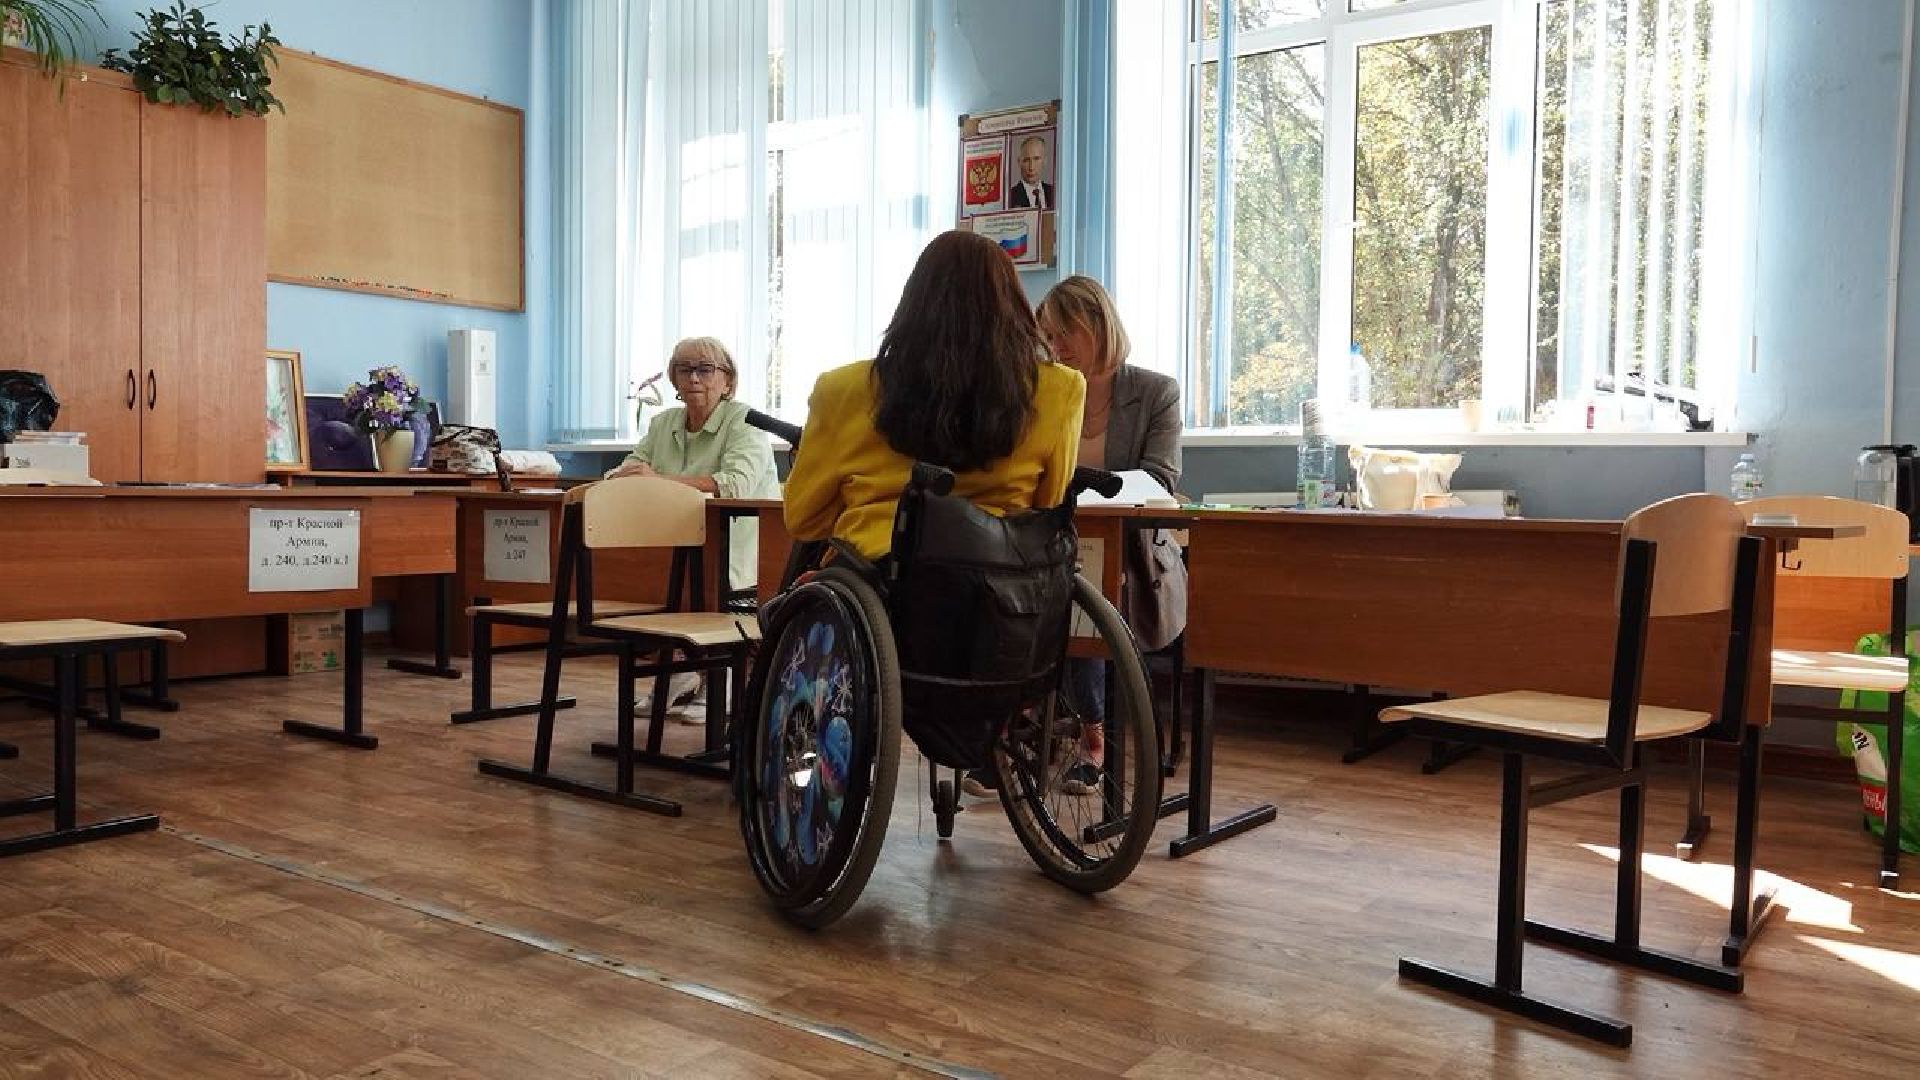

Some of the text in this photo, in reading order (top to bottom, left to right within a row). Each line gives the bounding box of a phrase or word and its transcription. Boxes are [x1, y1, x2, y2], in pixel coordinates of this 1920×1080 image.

[270, 517, 343, 531] пр-т Красной
[286, 536, 327, 549] Армии,
